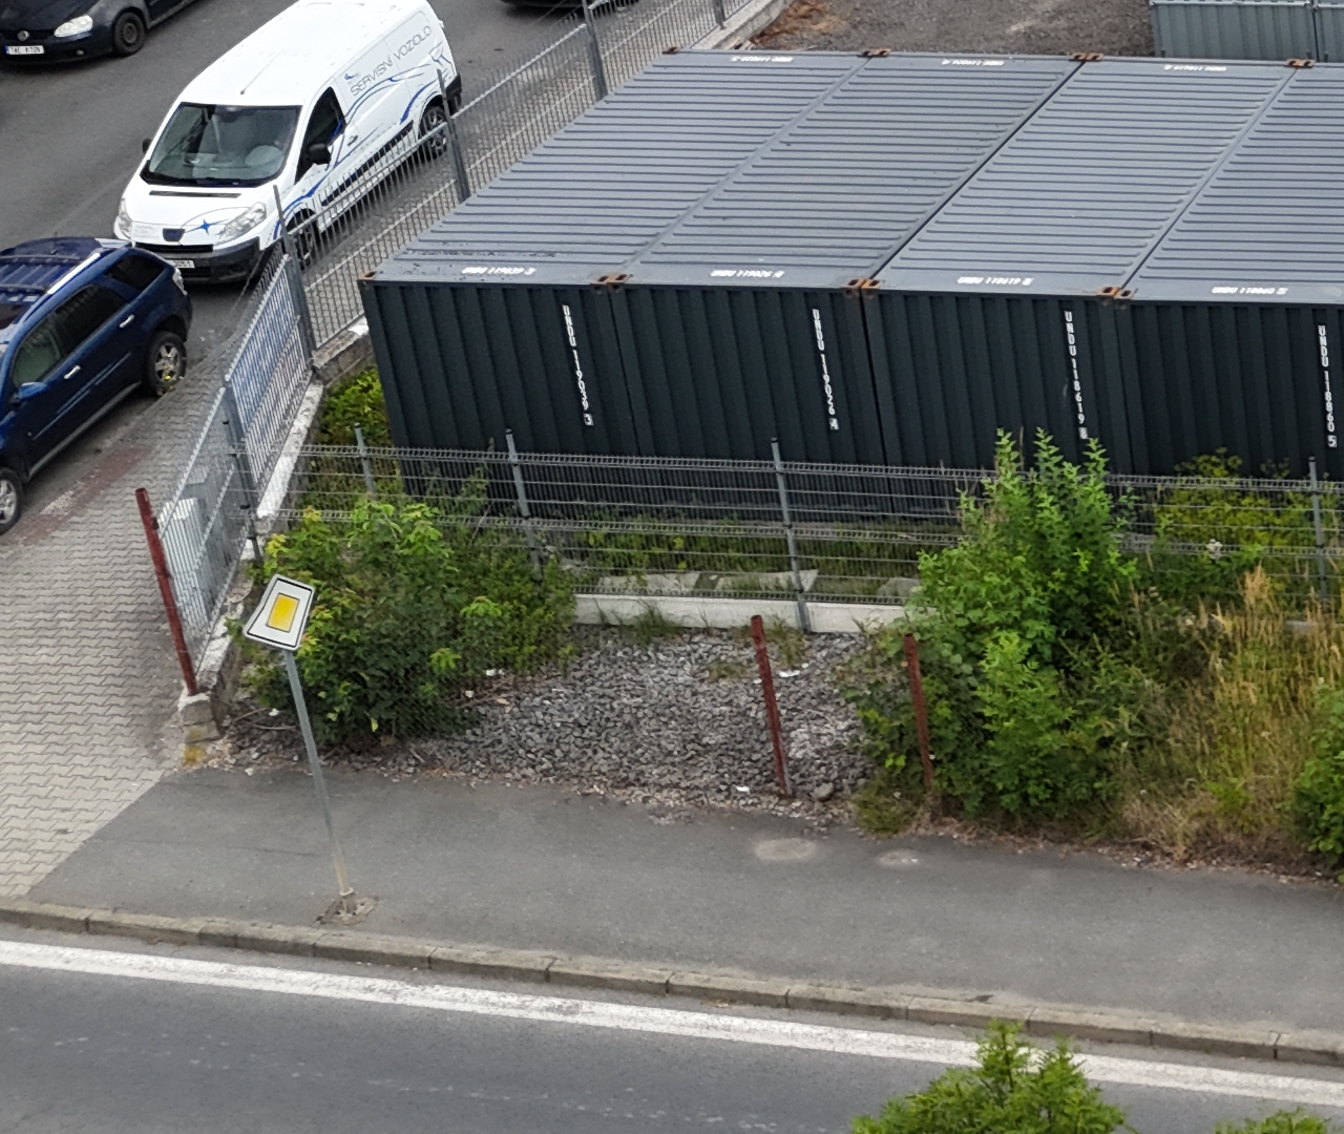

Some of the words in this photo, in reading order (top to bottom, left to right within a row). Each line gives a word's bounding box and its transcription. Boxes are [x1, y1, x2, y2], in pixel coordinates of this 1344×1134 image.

[1064, 310, 1077, 357] UNDU
[1071, 358, 1086, 425] 118619
[1318, 325, 1329, 369] UNDU
[1325, 370, 1335, 433] 118860
[1328, 434, 1337, 448] 5
